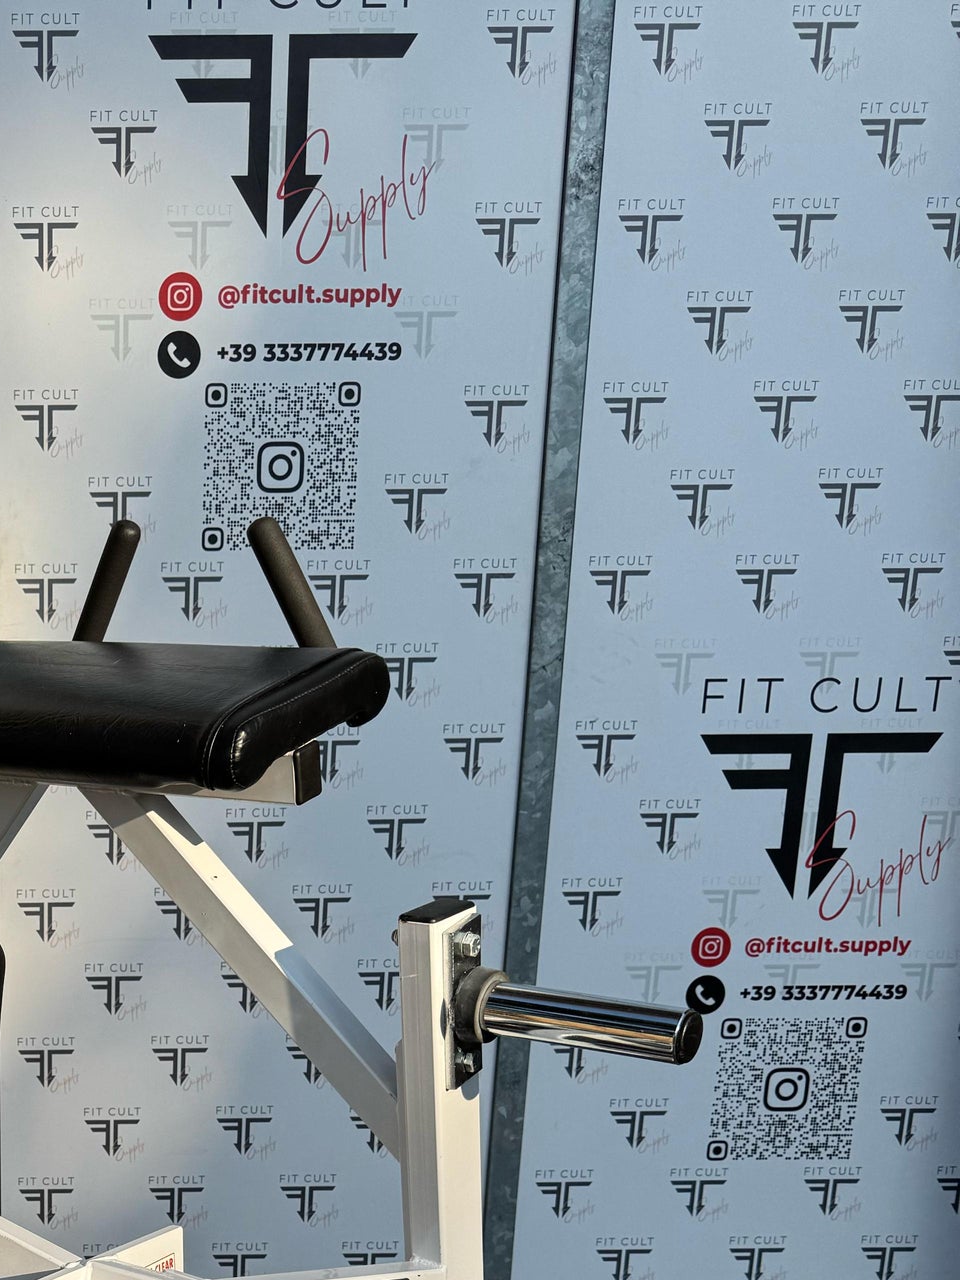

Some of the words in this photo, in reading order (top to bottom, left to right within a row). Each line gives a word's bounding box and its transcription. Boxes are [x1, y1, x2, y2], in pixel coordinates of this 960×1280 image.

[486, 9, 511, 22] FIT
[516, 8, 556, 22] CULT
[633, 5, 658, 19] FIT
[663, 5, 704, 19] CULT
[792, 4, 817, 17] FIT
[821, 4, 862, 17] CULT
[11, 12, 35, 25] FIT
[40, 12, 80, 25] CULT
[704, 102, 728, 116] FIT
[733, 102, 773, 115] CULT
[860, 101, 884, 114] FIT
[889, 101, 929, 114] CULT
[89, 110, 113, 123] FIT
[118, 109, 158, 122] CULT
[276, 128, 436, 272] Supply
[617, 198, 641, 211] FIT
[646, 198, 686, 211] CULT
[772, 197, 796, 210] FIT
[801, 197, 841, 210] CULT
[12, 206, 35, 218] FIT
[40, 205, 80, 218] CULT
[217, 283, 403, 310] @fitcult.supply
[216, 344, 257, 362] +39
[262, 342, 402, 362] 3337774439
[602, 381, 626, 393] FIT
[630, 381, 670, 393] CULT
[753, 380, 777, 392] FIT
[781, 380, 820, 392] CULT
[818, 467, 841, 480] FIT
[846, 467, 884, 479] CULT
[88, 476, 110, 488] FIT
[115, 475, 153, 488] CULT
[881, 552, 904, 564] FIT
[908, 552, 947, 564] CULT
[306, 559, 329, 571] FIT
[334, 559, 372, 571] CULT
[700, 677, 785, 714] FIT
[808, 676, 953, 713] CULT
[442, 723, 465, 734] FIT
[469, 722, 506, 734] CULT
[639, 799, 661, 810] FIT
[665, 798, 702, 810] CULT
[804, 810, 951, 927] Supply
[561, 877, 583, 888] FIT
[587, 876, 624, 888] CULT
[291, 884, 313, 895] FIT
[317, 883, 353, 895] CULT
[744, 936, 912, 958] @fitcult.supply
[84, 962, 105, 973] FIT
[109, 962, 144, 973] CULT
[739, 986, 777, 1001] +39
[782, 984, 908, 1001] 3337774439
[150, 1035, 171, 1045] FIT
[175, 1034, 210, 1045] CULT
[879, 1095, 901, 1106] FIT
[904, 1095, 939, 1106] CULT
[803, 1166, 825, 1176] FIT
[828, 1166, 863, 1176] CULT
[279, 1173, 299, 1184] FIT
[303, 1173, 337, 1184] CULT
